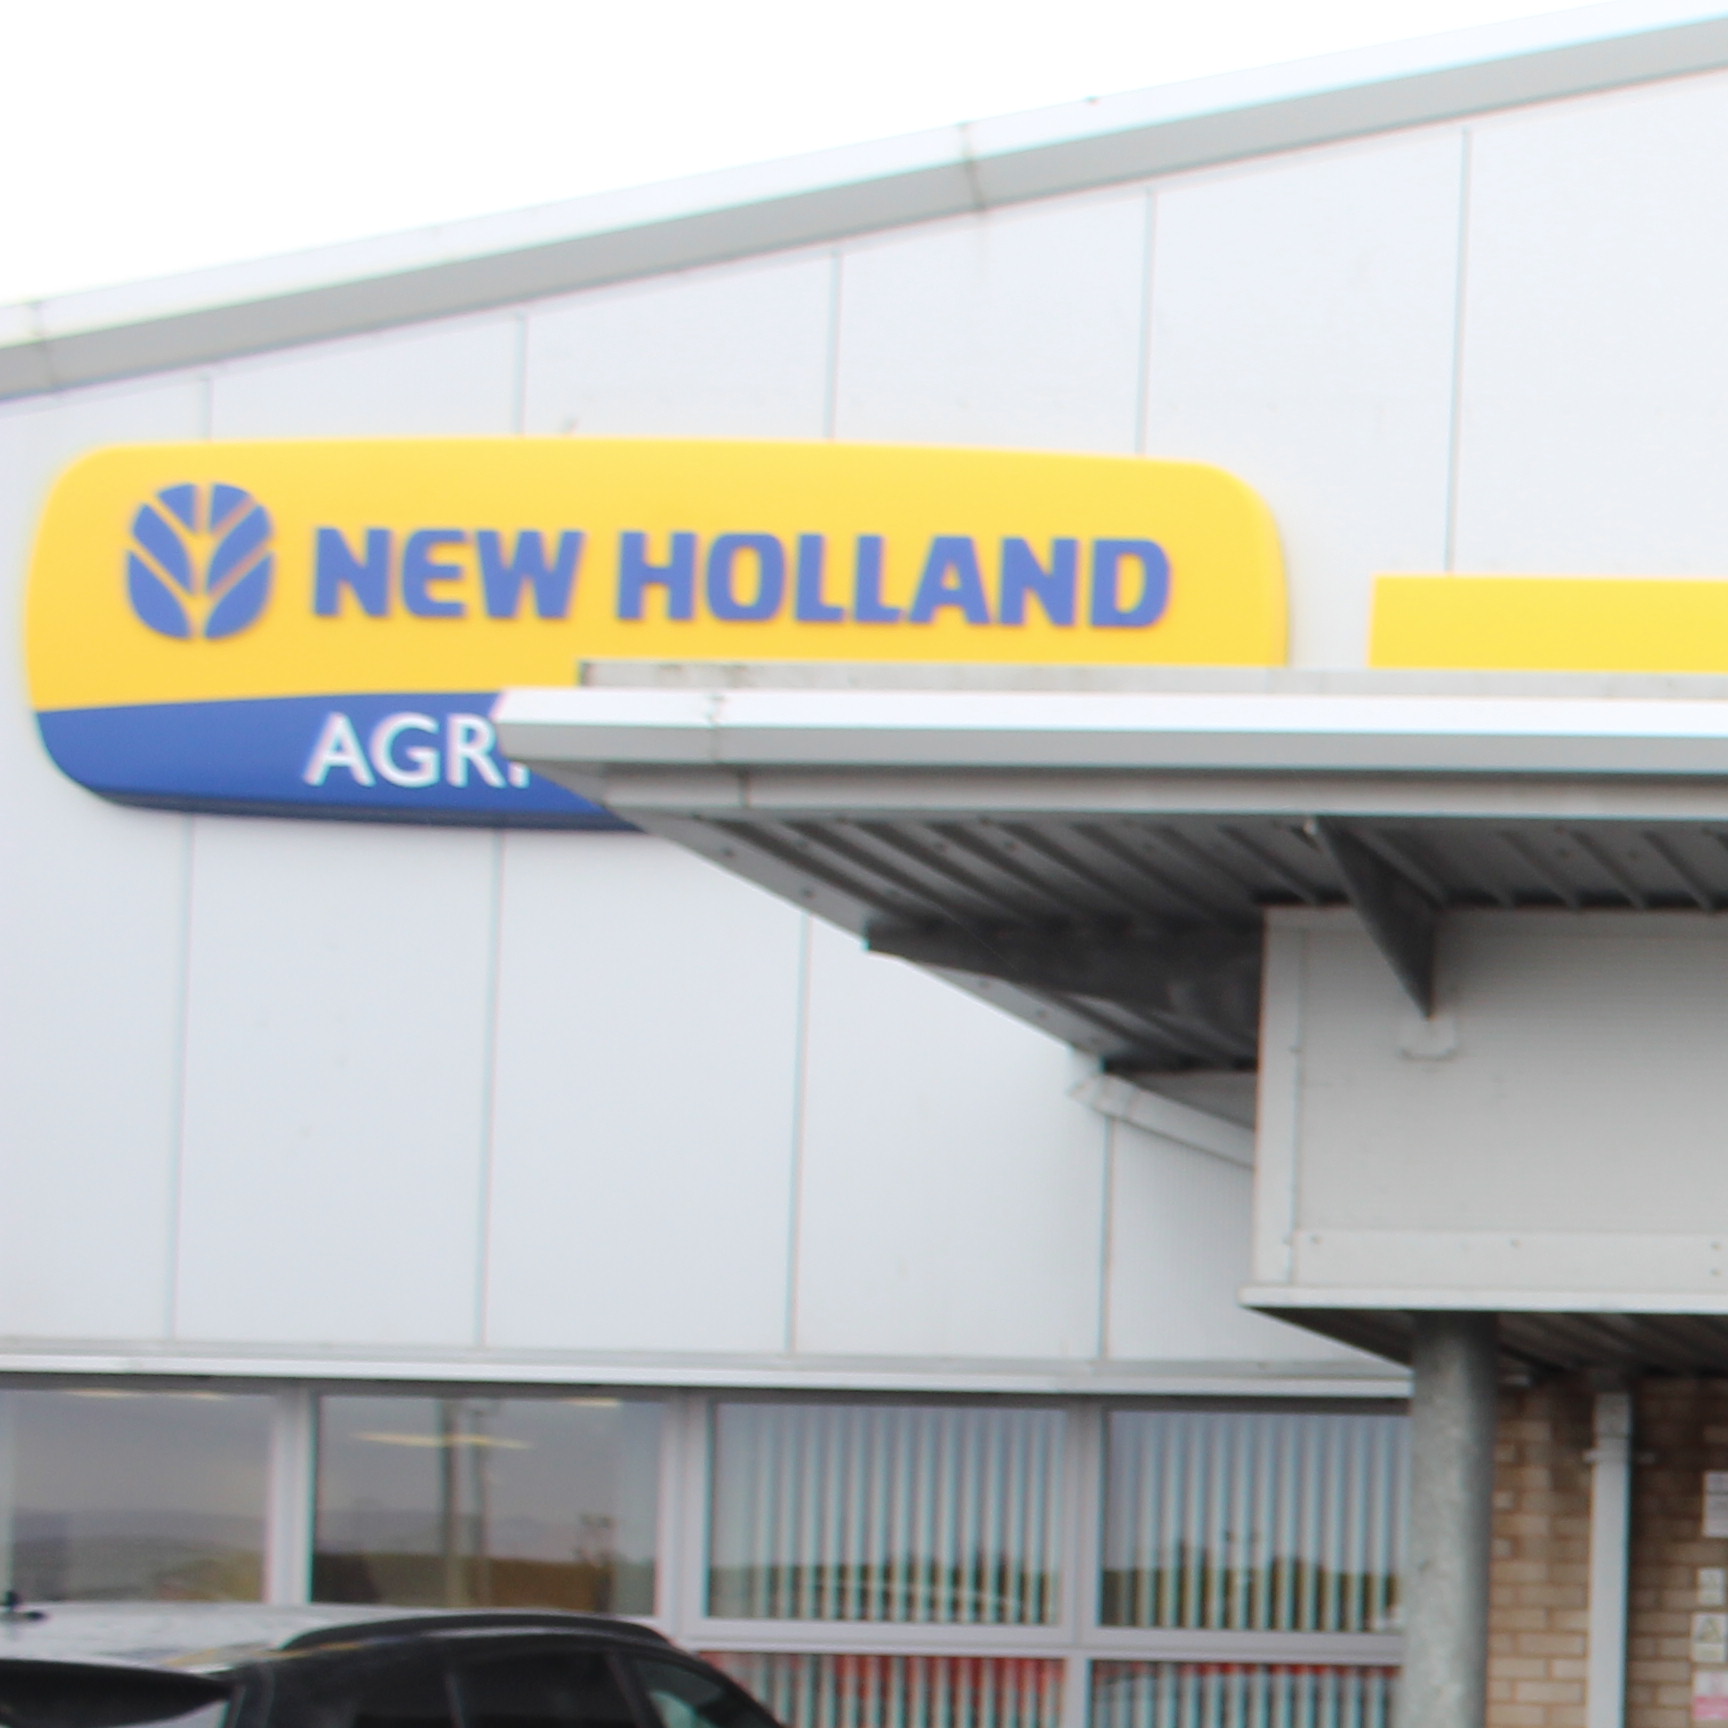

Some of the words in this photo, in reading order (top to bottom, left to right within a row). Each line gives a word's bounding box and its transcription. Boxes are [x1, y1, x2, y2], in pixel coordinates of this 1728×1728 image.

[312, 526, 585, 618] NEW
[616, 530, 1171, 628] HOLLAND
[302, 710, 530, 788] AGR
